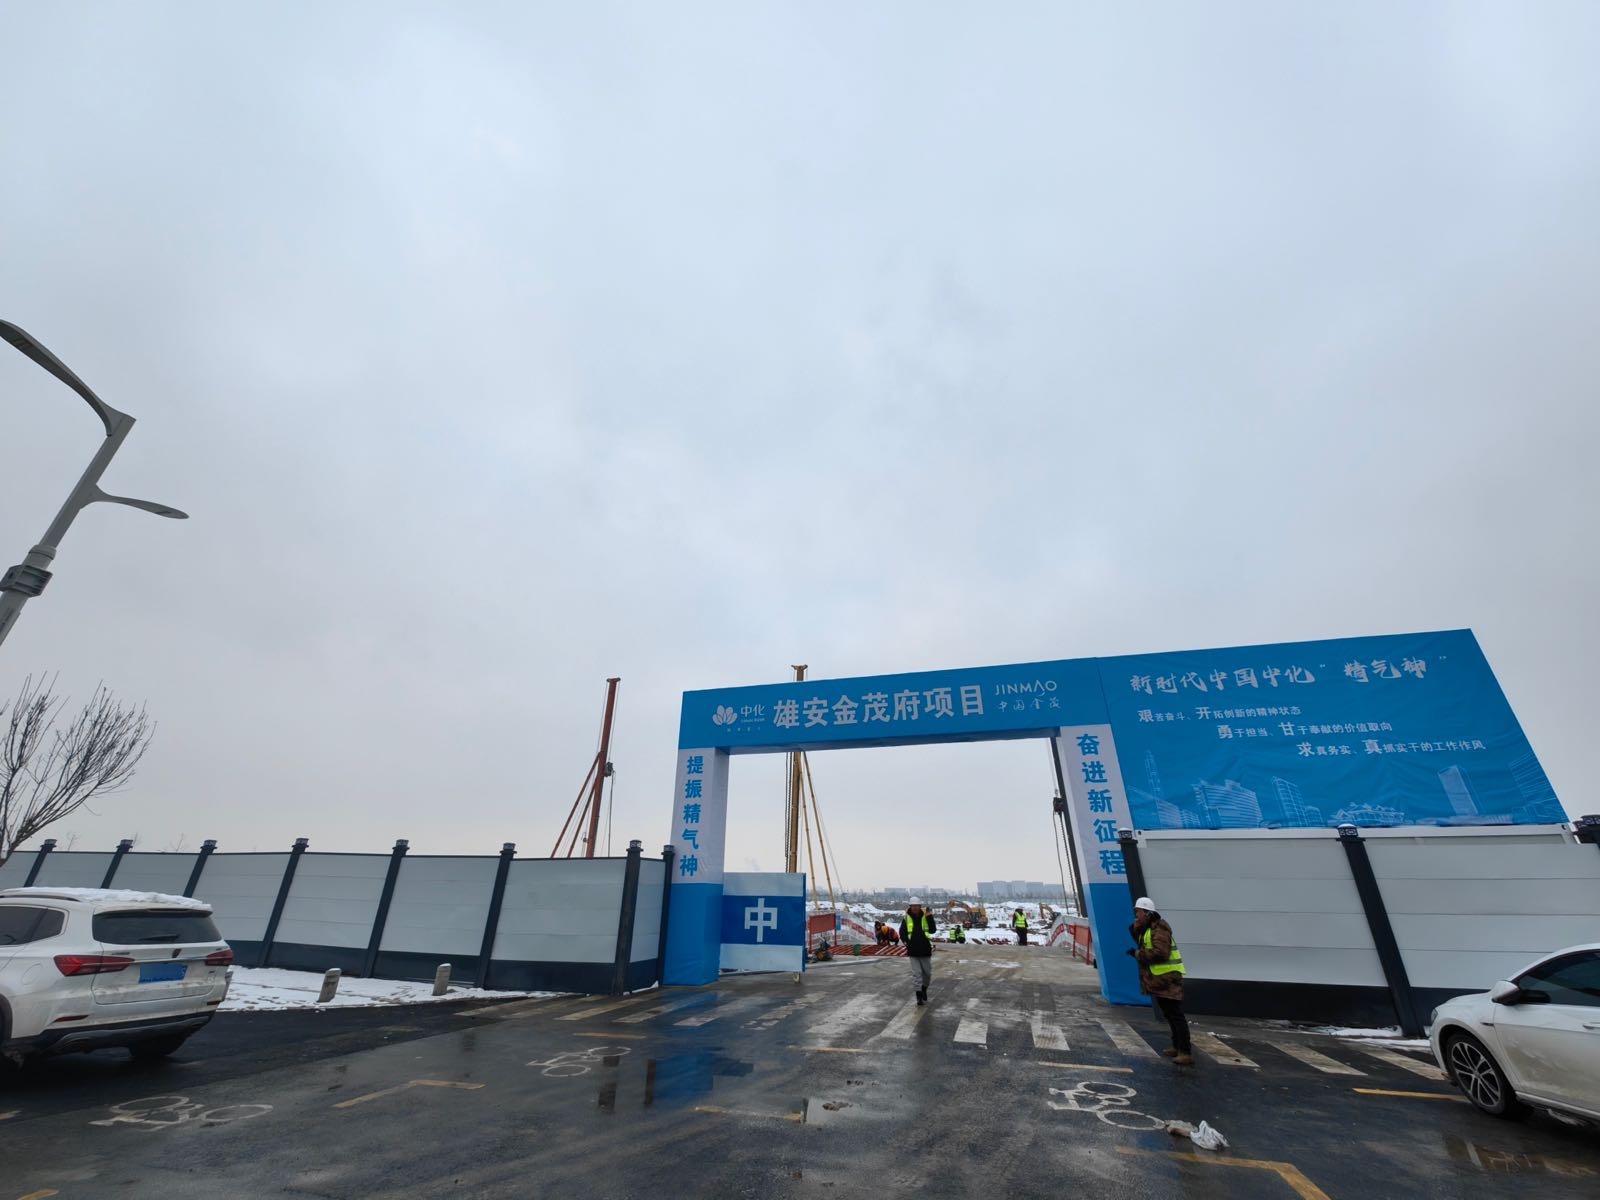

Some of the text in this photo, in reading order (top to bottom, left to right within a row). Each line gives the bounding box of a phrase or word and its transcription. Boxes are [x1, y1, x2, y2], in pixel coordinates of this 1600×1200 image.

[740, 704, 765, 717] 中化
[773, 684, 985, 729] 雄安金茂府项目
[995, 680, 1057, 697] JINMAO
[680, 756, 703, 876] 提振精气神
[1076, 734, 1126, 875] 奋进新征程
[744, 898, 778, 942] 中
